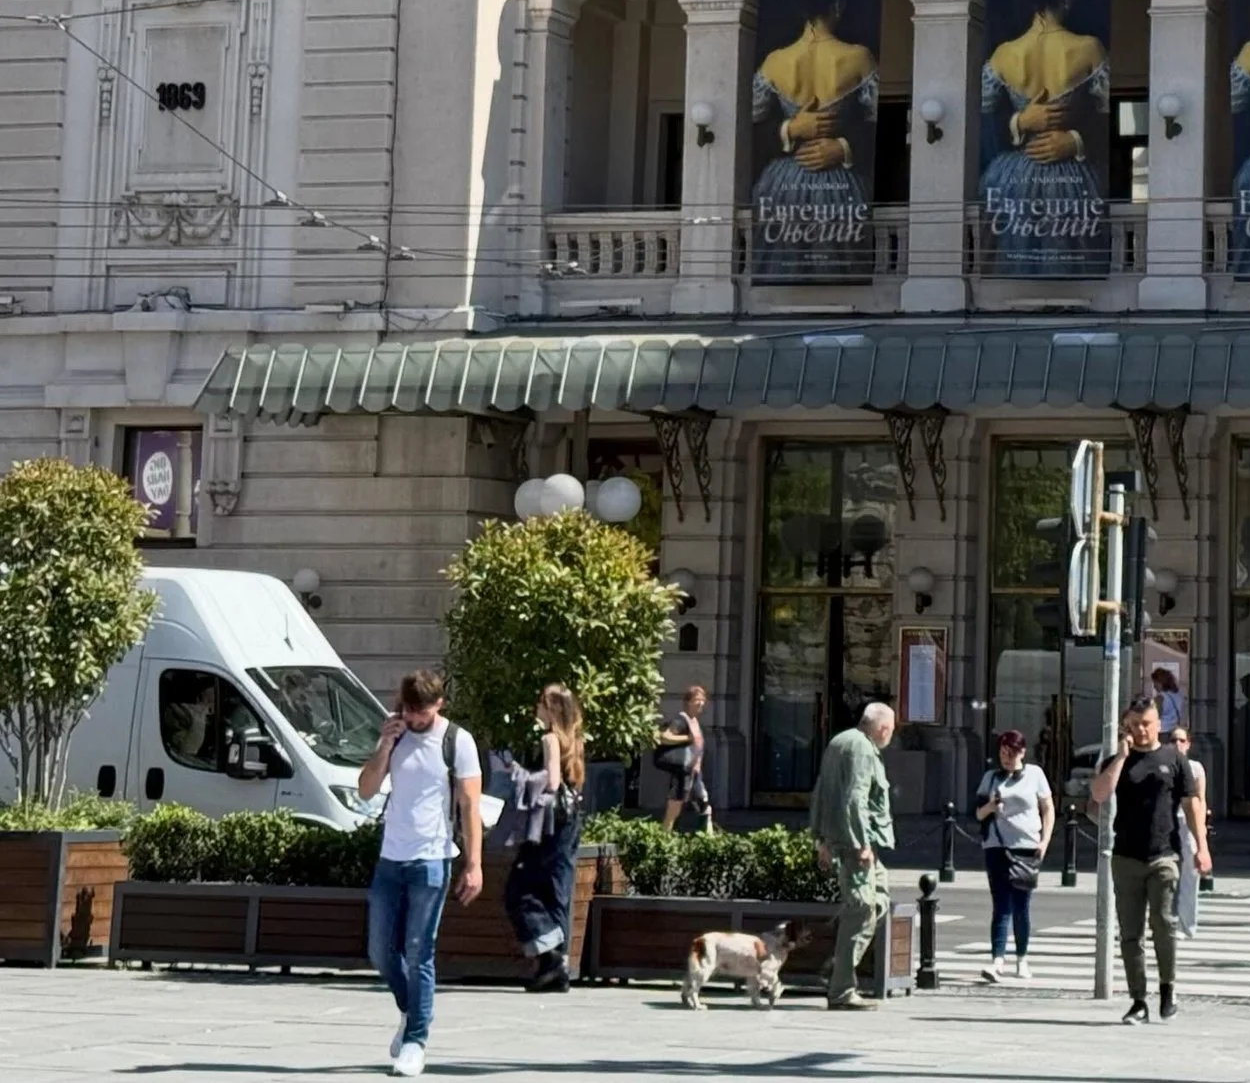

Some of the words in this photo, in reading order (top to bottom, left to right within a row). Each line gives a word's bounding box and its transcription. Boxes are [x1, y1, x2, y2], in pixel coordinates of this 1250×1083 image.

[156, 82, 206, 111] 1869
[759, 196, 868, 230] Евгеније
[985, 188, 1104, 222] Евгеније
[764, 214, 865, 243] Оњегин
[991, 209, 1101, 238] Оњегин
